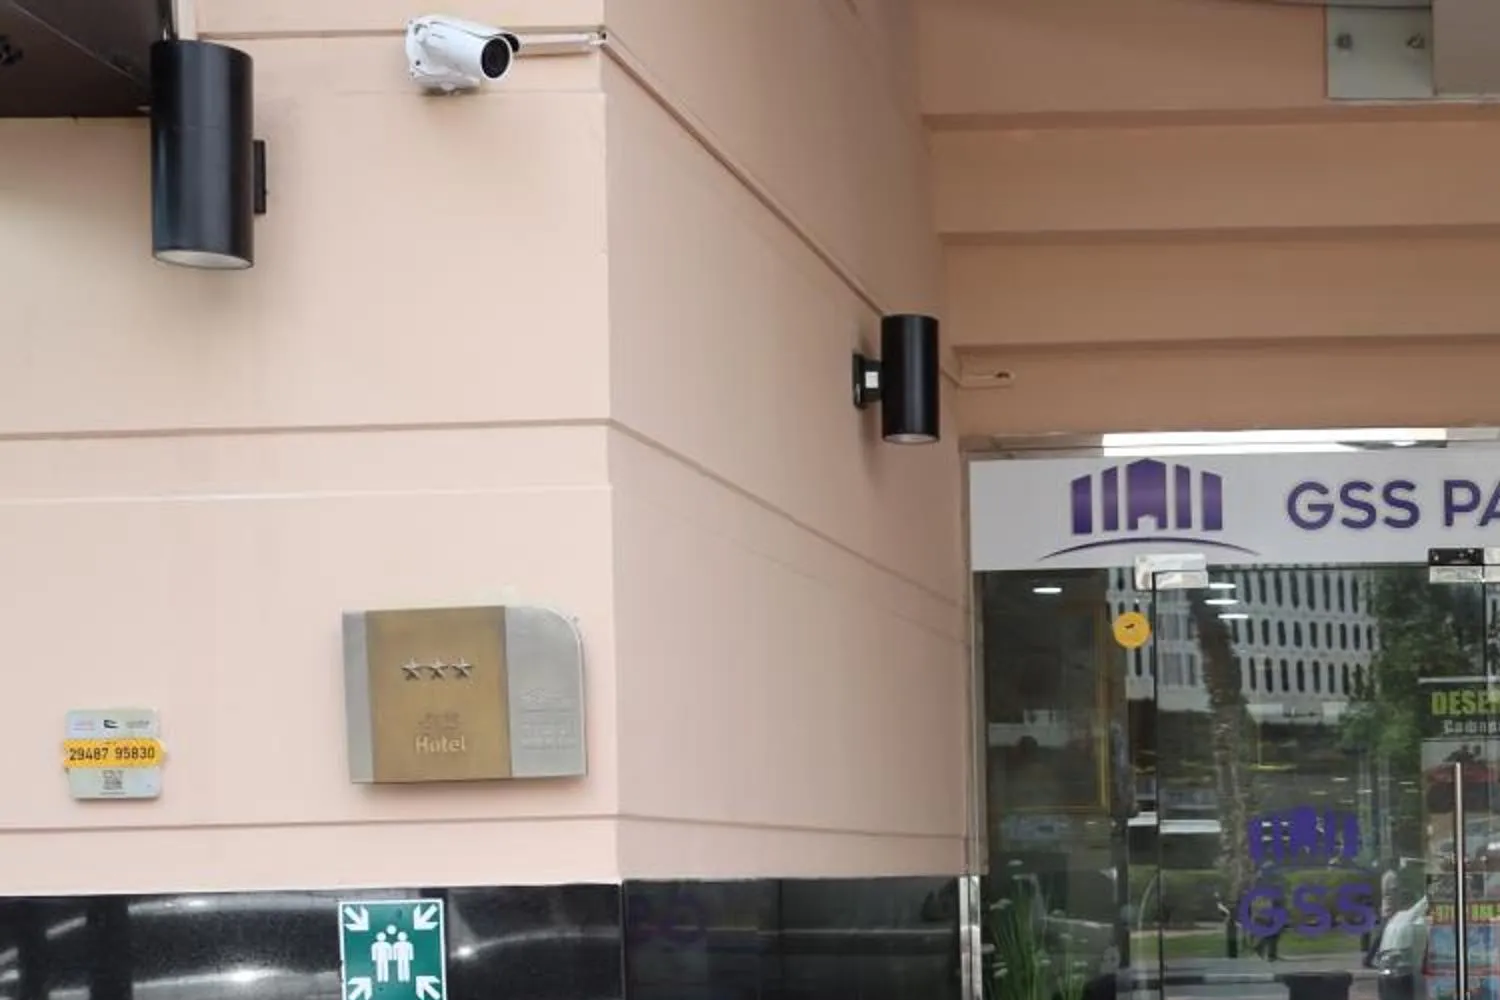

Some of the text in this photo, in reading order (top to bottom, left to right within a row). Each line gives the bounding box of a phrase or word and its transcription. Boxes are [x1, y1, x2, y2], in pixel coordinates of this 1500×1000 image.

[1286, 479, 1421, 531] GSS
[69, 745, 156, 761] 29487 95830
[415, 734, 466, 754] Hotel
[1237, 883, 1378, 938] GSS
